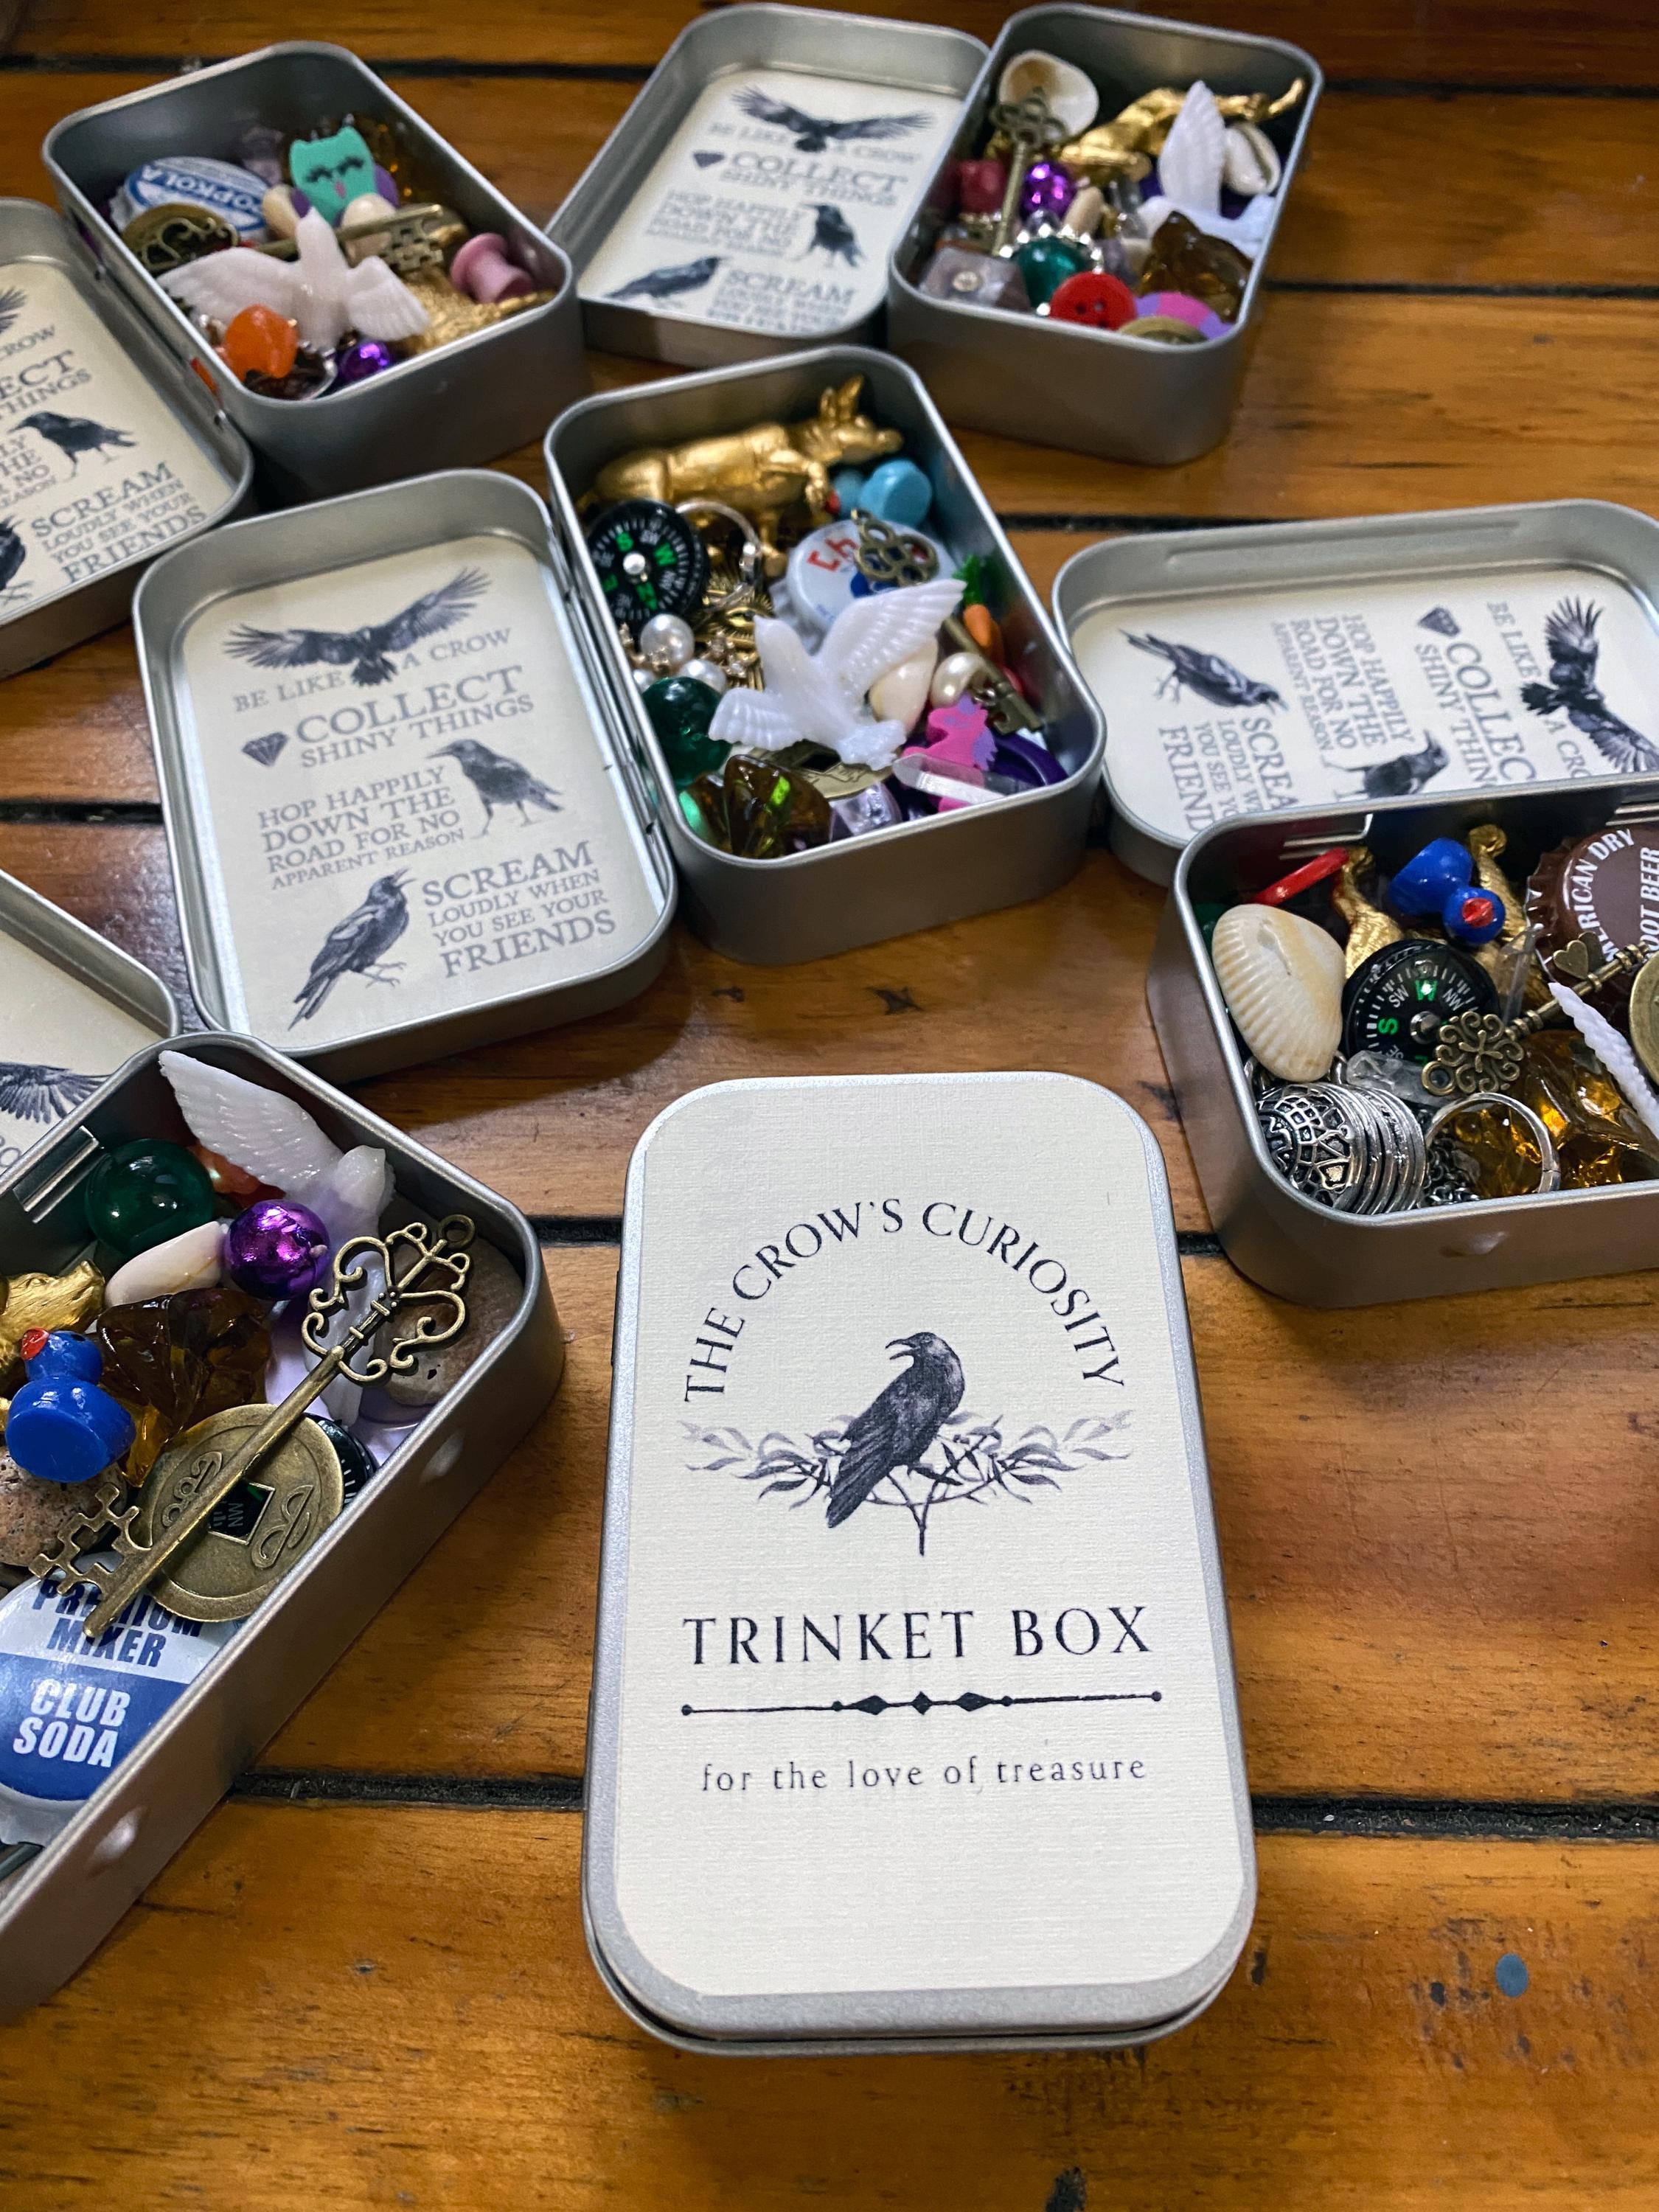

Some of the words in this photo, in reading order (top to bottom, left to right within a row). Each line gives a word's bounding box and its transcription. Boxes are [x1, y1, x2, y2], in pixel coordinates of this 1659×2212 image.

[141, 164, 261, 215] OPKOLA
[732, 150, 908, 193] COLLECT
[0, 368, 92, 422] HINGS
[32, 462, 173, 537] SCREAM
[42, 509, 117, 551] LOUDLY
[123, 479, 184, 511] WHEN
[51, 538, 94, 563] YOU
[98, 519, 136, 543] SEE
[139, 493, 192, 522] YOUR
[61, 506, 207, 582] FRIENDS
[1487, 602, 1515, 625] BE
[232, 690, 269, 713] BE
[277, 670, 345, 701] LIKE
[403, 653, 420, 669] A
[430, 628, 512, 662] CROW
[1290, 619, 1326, 669] ROAD
[1312, 676, 1344, 713] FOR
[1329, 719, 1357, 748] NO
[1315, 617, 1366, 687] DOWN
[1348, 693, 1388, 746] THE
[1342, 614, 1376, 653] HOP
[1360, 658, 1416, 742] HAPPILY
[1500, 631, 1541, 677] LIKE
[296, 665, 523, 744] COLLECT
[301, 727, 397, 768] SHINY
[410, 695, 535, 739] THINGS
[1415, 644, 1465, 712] SHINY
[1450, 719, 1498, 787] THIN
[1447, 642, 1537, 780] COLLEC
[1543, 719, 1566, 734] A
[1158, 726, 1216, 832] FRIEND
[1194, 722, 1220, 757] YOU
[1207, 761, 1231, 792] SEE
[1217, 720, 1253, 783] LOUDLY
[1242, 717, 1298, 811] SCREA
[1557, 740, 1591, 777] CRO
[259, 799, 317, 829] HOP
[326, 765, 445, 811] HAPPILY
[262, 807, 369, 852] DOWN
[380, 787, 456, 821] THE
[267, 839, 346, 874] ROAD
[354, 822, 411, 850] FOR
[418, 810, 460, 834] NO
[271, 852, 379, 891] APPARENT
[385, 828, 465, 860] REASON
[422, 840, 594, 907] SCREAM
[1587, 829, 1635, 860] DRY
[1640, 846, 1659, 902] BEER
[428, 890, 519, 928] LOUDLY
[528, 869, 600, 900] WHEN
[433, 922, 483, 947] YOU
[492, 908, 535, 932] SEE
[541, 889, 608, 919] YOUR
[1640, 904, 1659, 956] OOT
[440, 909, 616, 978] FRIENDS
[1378, 1018, 1399, 1035] S
[1389, 984, 1410, 1009] SW
[1415, 980, 1438, 1001] W
[1441, 988, 1465, 1012] NW
[684, 1307, 745, 1402] THE
[732, 1198, 903, 1300] CROW'S
[922, 1202, 1125, 1388] CURIOSITY
[683, 1610, 974, 1666] TRINKET
[1011, 1606, 1153, 1658] BOX
[30, 1678, 131, 1728] CLUB
[13, 1717, 119, 1768] SODA
[702, 1763, 751, 1792] for
[773, 1761, 827, 1790] the
[848, 1760, 922, 1790] love
[944, 1755, 978, 1785] of
[997, 1757, 1147, 1784] treasure
